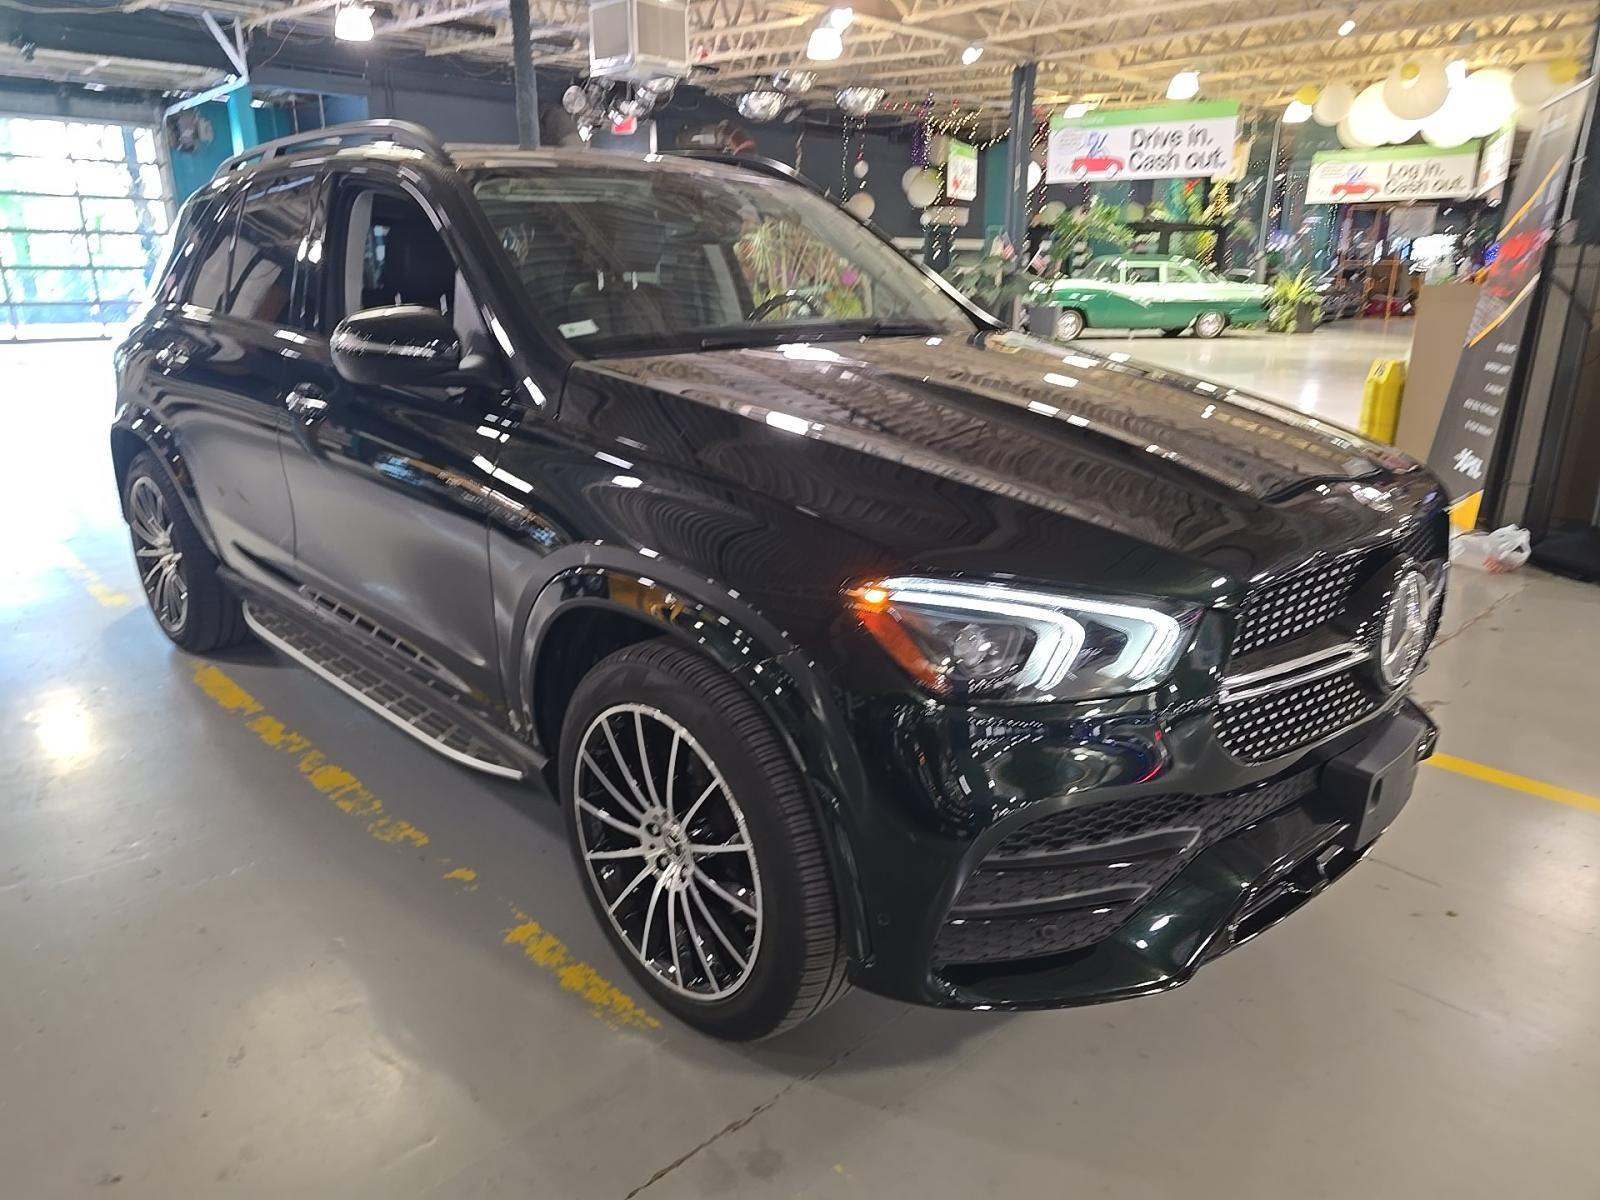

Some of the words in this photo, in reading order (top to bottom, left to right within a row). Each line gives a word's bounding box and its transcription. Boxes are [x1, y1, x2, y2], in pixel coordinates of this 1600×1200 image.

[1130, 127, 1183, 149] Drive
[1187, 124, 1214, 147] in.
[1129, 149, 1180, 172] Cash
[1185, 147, 1227, 170] out.
[1387, 163, 1421, 180] Log
[1384, 177, 1429, 194] Cash
